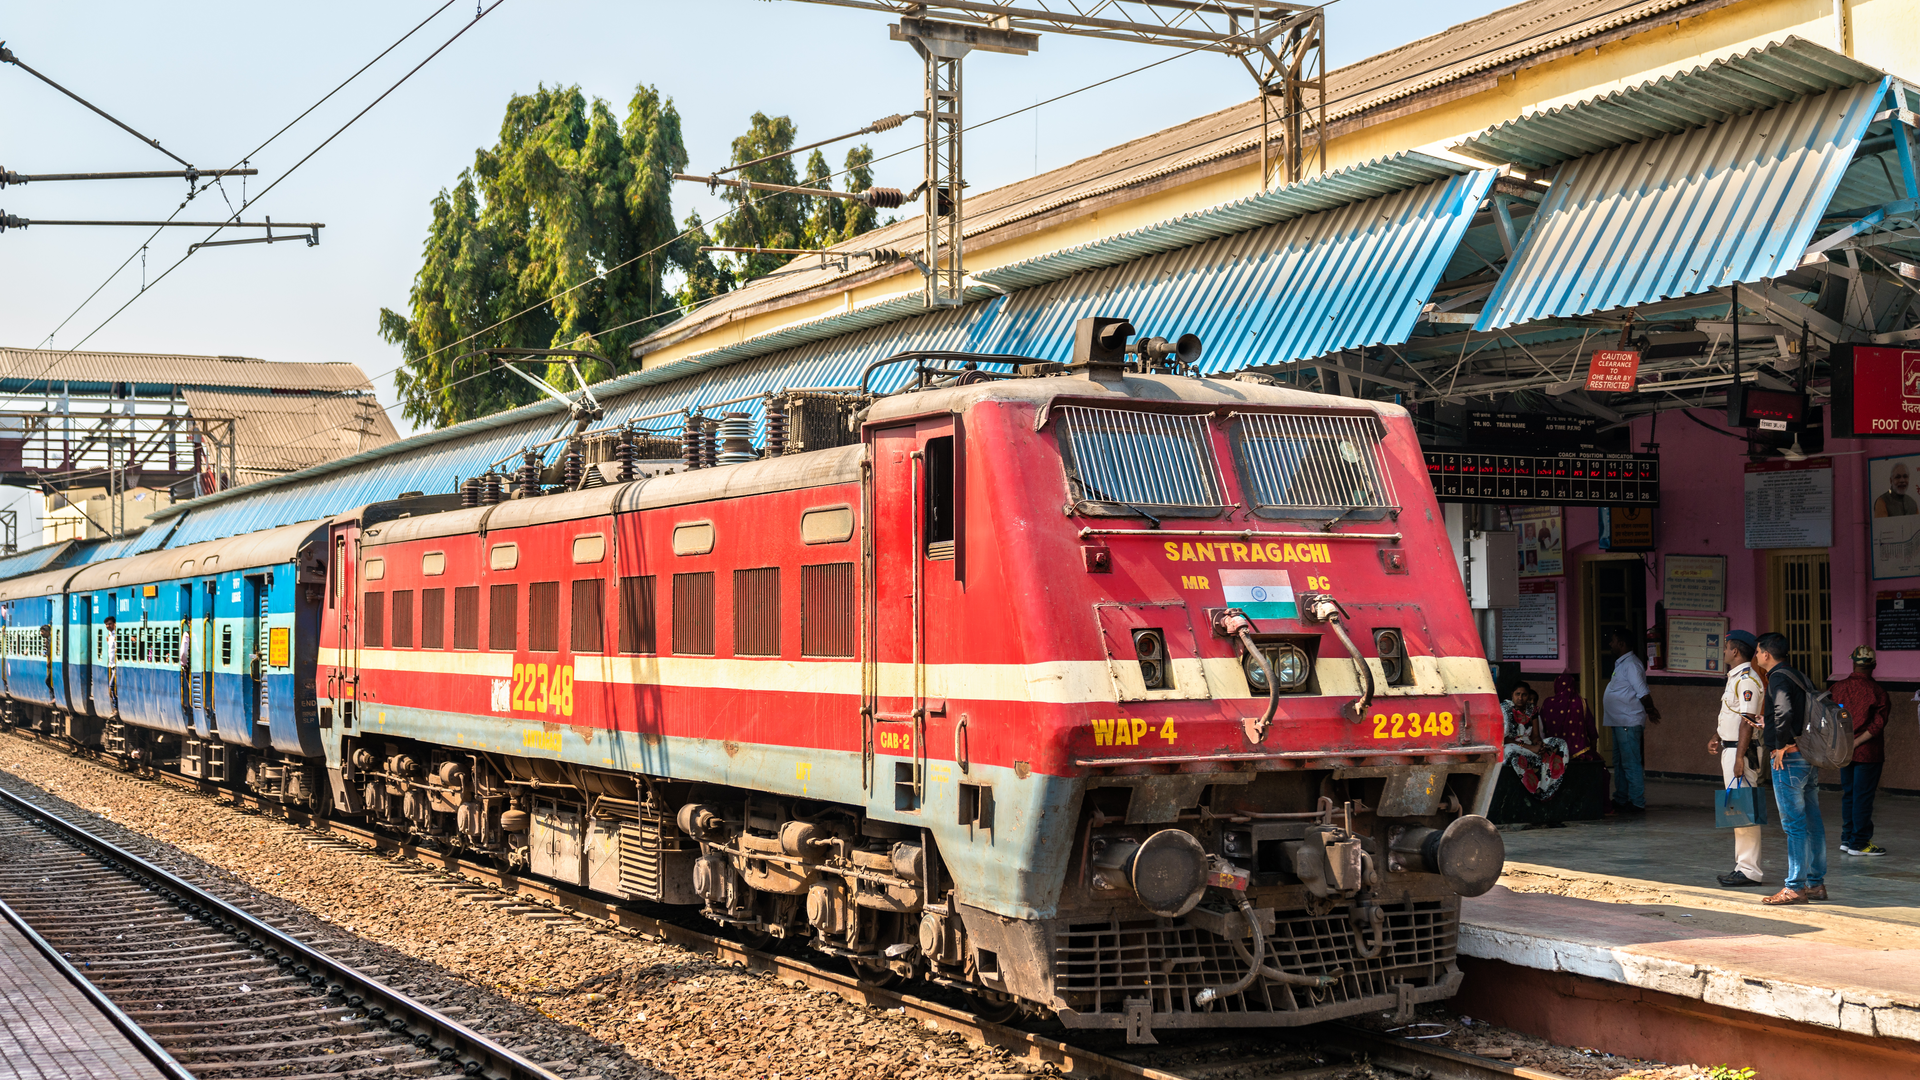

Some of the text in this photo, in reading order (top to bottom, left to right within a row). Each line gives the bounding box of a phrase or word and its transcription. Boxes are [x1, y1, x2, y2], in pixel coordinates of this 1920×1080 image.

[1601, 352, 1633, 361] CAUTION
[1598, 360, 1632, 368] CLEARANCE
[1590, 381, 1630, 390] RESTRICTED
[1872, 418, 1899, 430] FOOT
[1449, 456, 1454, 464] 2
[1503, 458, 1508, 466] 5
[1559, 460, 1564, 468] 8
[1625, 462, 1633, 470] 12
[1447, 486, 1456, 494] 15
[1466, 487, 1475, 495] 16
[1501, 488, 1510, 496] 18
[1519, 489, 1528, 497] 19
[1540, 489, 1549, 497] 20
[1163, 541, 1332, 563] SANTRAGACHI
[1181, 575, 1210, 590] MR
[1307, 576, 1331, 590] BC
[512, 663, 573, 717] 22348
[301, 699, 317, 707] END
[1091, 717, 1178, 746] WAP-4
[1373, 711, 1454, 739] 22348
[880, 731, 910, 750] CAB-2
[796, 761, 812, 781] LIFT
